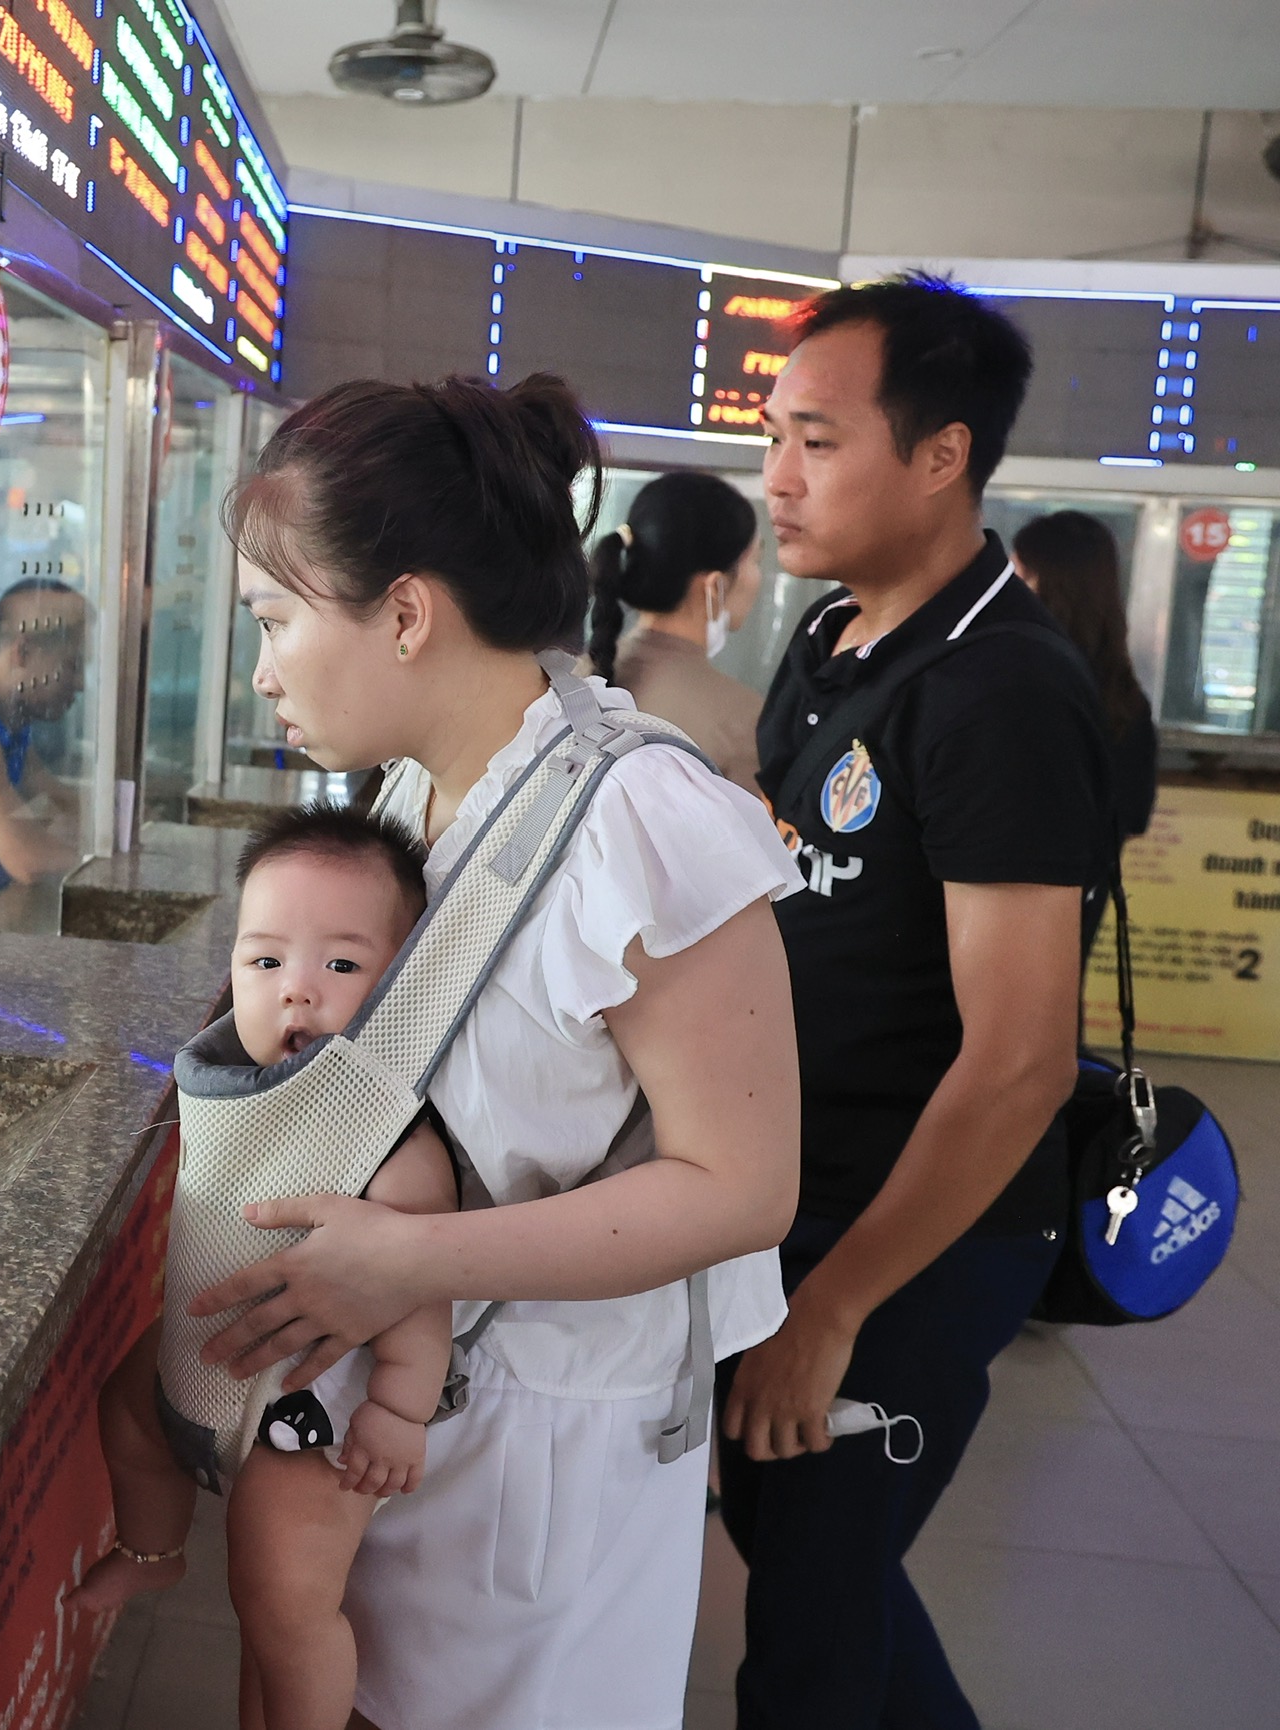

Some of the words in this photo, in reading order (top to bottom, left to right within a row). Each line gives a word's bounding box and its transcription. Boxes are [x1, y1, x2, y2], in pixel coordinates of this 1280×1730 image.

[1186, 521, 1227, 547] 15
[1235, 949, 1262, 981] 2
[1151, 1201, 1221, 1264] adidas
